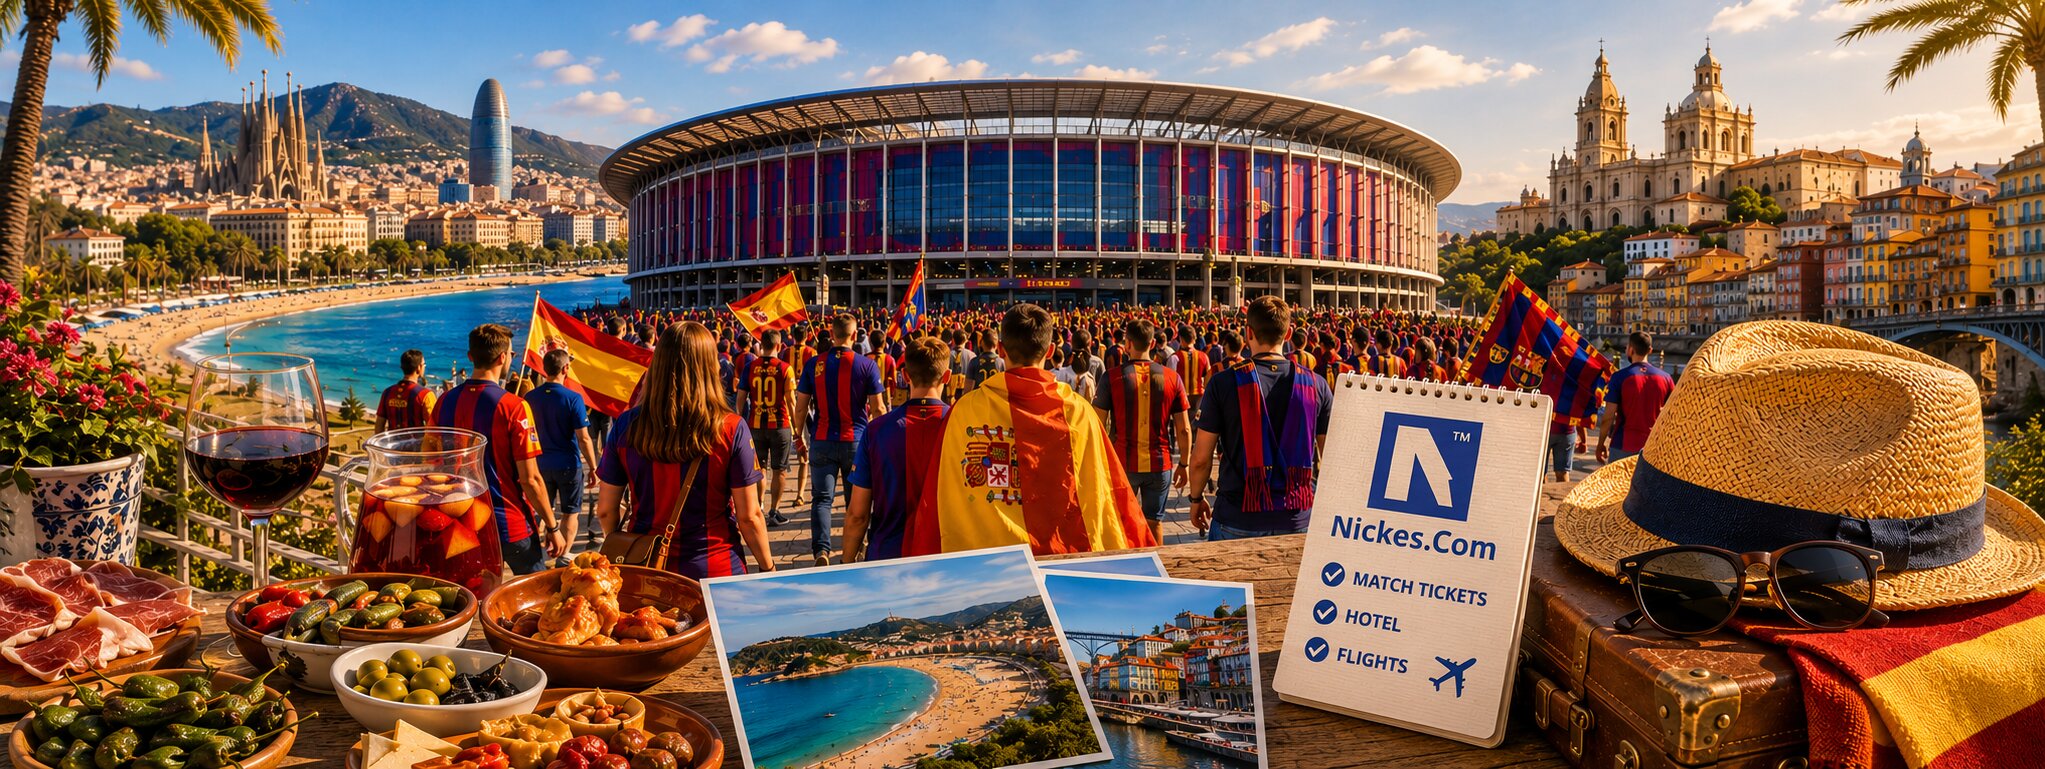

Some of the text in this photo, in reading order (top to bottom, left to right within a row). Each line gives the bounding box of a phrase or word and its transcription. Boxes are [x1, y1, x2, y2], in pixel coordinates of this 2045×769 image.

[1452, 431, 1471, 443] TM
[1330, 515, 1497, 561] Nickes.Com
[1353, 571, 1488, 607] MATCH TICKETS
[1345, 608, 1401, 633] HOTEL
[1336, 647, 1409, 674] FLIGHTS
